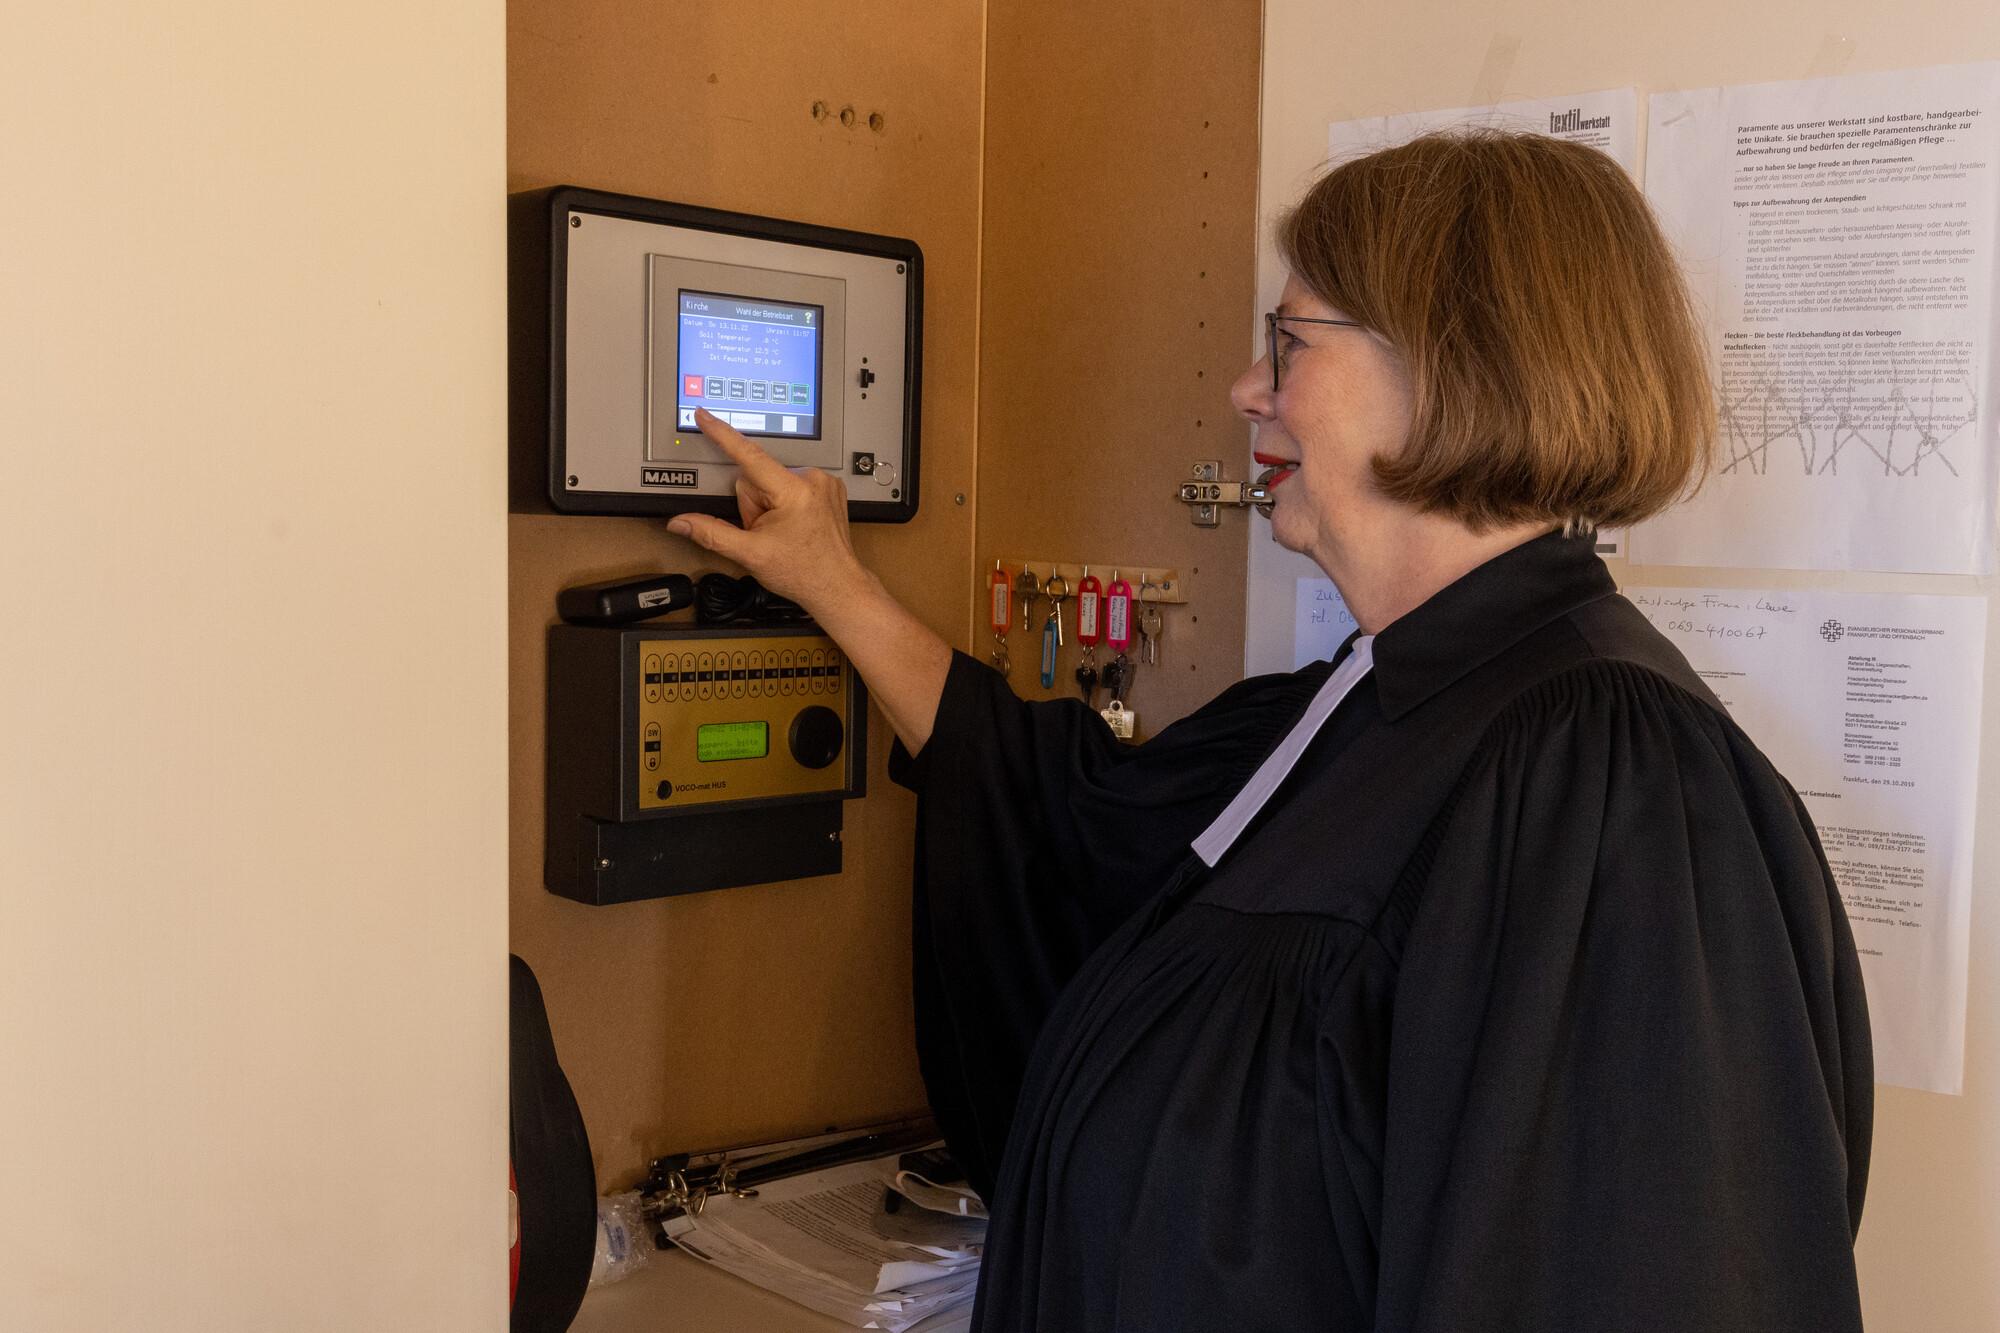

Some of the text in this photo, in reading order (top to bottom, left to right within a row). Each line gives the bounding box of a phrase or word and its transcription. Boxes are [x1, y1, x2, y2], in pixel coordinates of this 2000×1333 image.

[1738, 124, 1779, 133] Paramente
[1797, 120, 1825, 129] unserer
[1828, 118, 1866, 127] Werkstatt
[1868, 115, 1884, 124] sind
[1887, 114, 1924, 122] kostbare,
[1926, 108, 1982, 120] handgearbei-
[1754, 135, 1784, 143] Unikate.
[1786, 134, 1798, 142] Sie
[1800, 131, 1835, 140] brauchen
[1837, 129, 1870, 139] spezielle
[1873, 122, 1956, 136] Paramentenschränke
[1736, 146, 1791, 156] Aufbewahrung
[1810, 143, 1844, 152] bedürfen
[1846, 141, 1859, 149] der
[1862, 138, 1916, 150] regelmäßigen
[1918, 136, 1944, 145] Pflege
[1764, 164, 1785, 172] haben
[1798, 162, 1816, 170] lange
[1818, 160, 1840, 168] Freude
[1872, 156, 1914, 164] Paramenten.
[1762, 198, 1810, 206] Aufbewahrung
[1824, 194, 1866, 204] Antependien
[686, 300, 708, 311] Kirche
[736, 307, 752, 316] Wahl
[763, 310, 794, 321] Betriebsart
[684, 318, 703, 327] Datum
[1786, 331, 1840, 339] Fleckbehandlung
[1866, 330, 1902, 338] Vorbeugen
[645, 472, 694, 484] MAHR
[648, 729, 658, 737] SW
[675, 781, 726, 792] VOCO-mat HUS
[1809, 791, 1841, 799] Gemeinden
